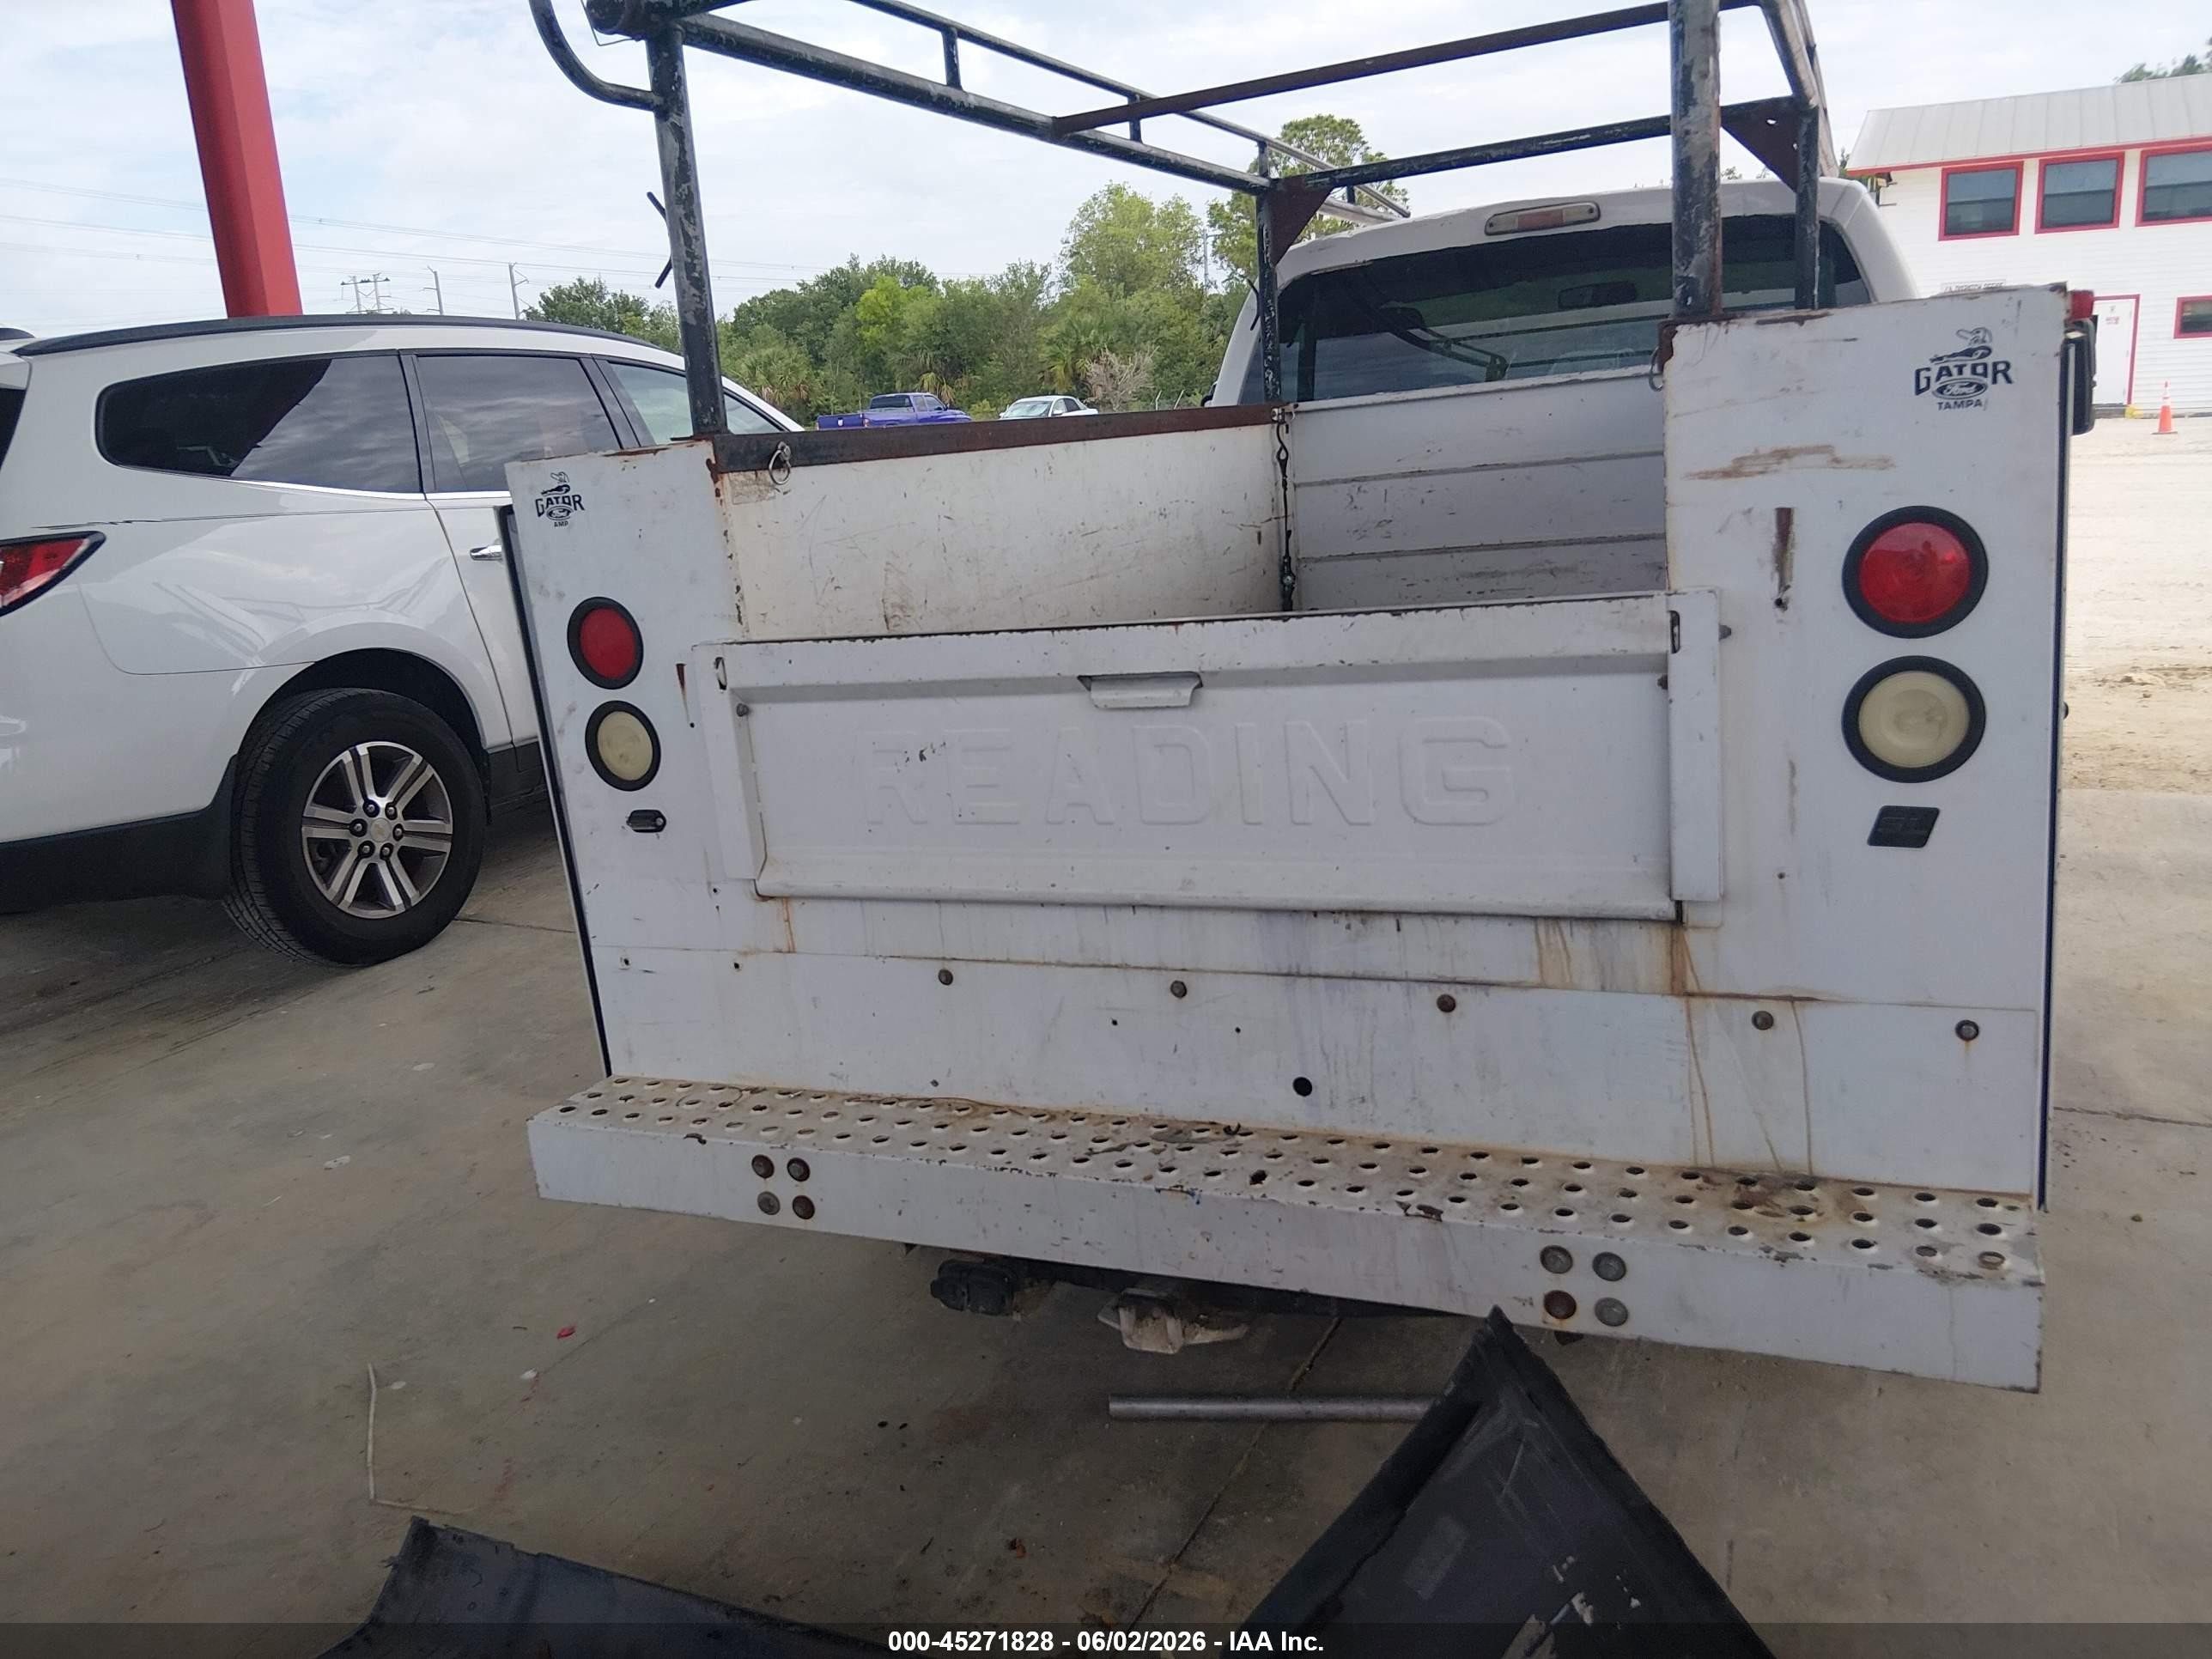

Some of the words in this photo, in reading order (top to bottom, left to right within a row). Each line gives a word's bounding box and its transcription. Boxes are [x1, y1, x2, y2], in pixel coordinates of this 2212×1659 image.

[1914, 360, 2014, 396] GATOR
[1936, 398, 1984, 411] TAMPA
[535, 494, 586, 518] GATOR
[859, 716, 1515, 827] READING
